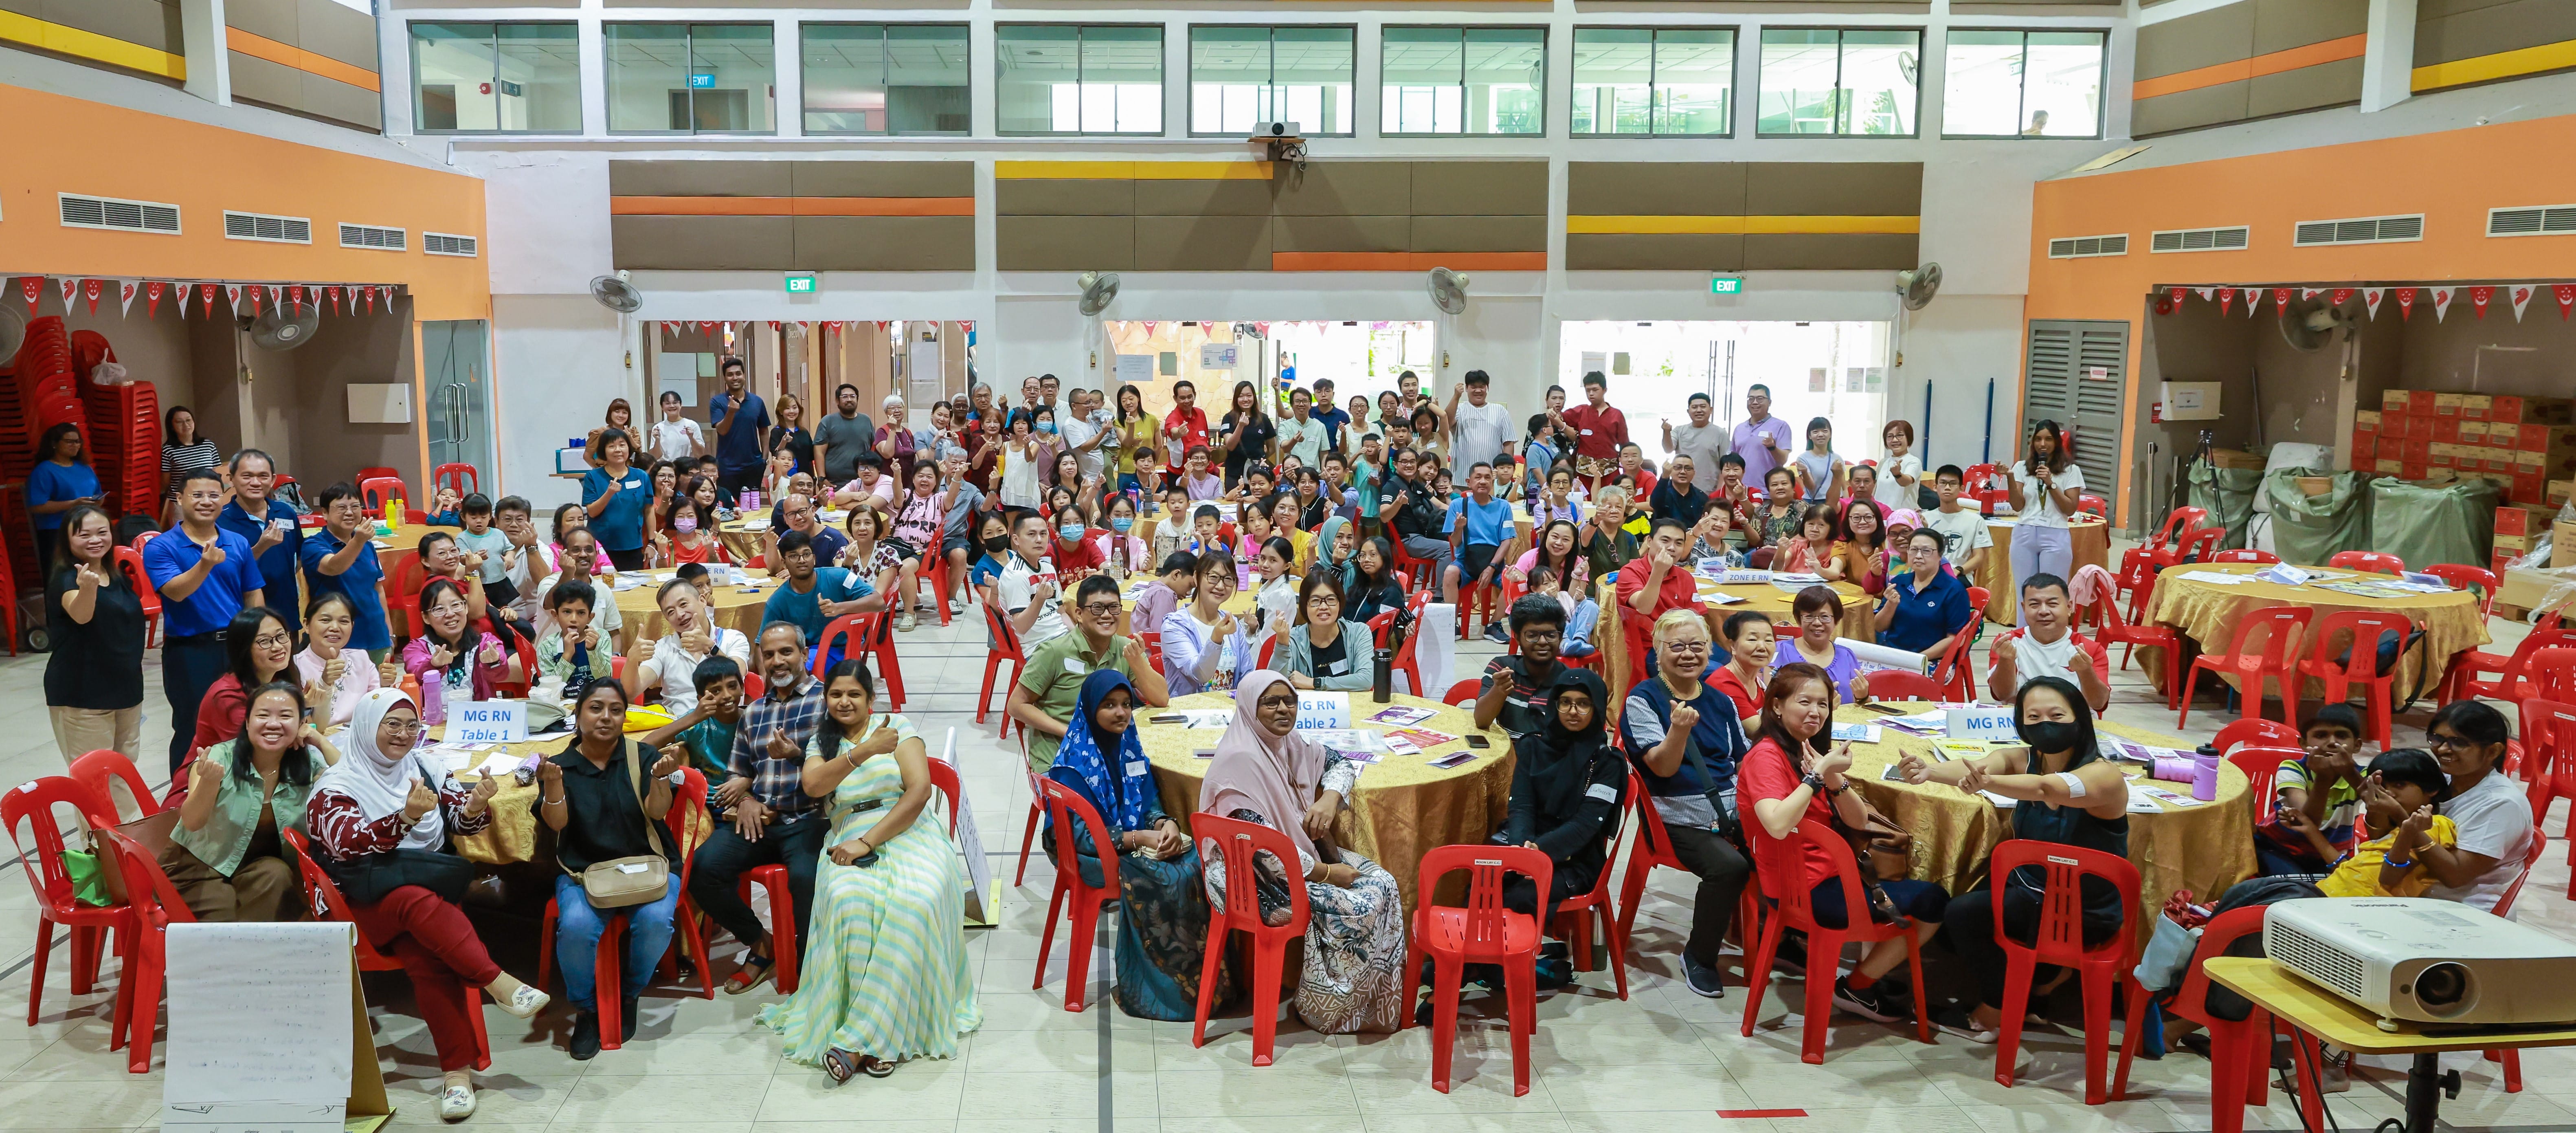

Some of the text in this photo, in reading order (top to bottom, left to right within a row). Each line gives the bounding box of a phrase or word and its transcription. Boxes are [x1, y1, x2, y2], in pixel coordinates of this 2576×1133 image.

[693, 76, 708, 85] EXIT
[790, 279, 810, 290] EXIT
[1717, 281, 1736, 291] EXIT
[1298, 701, 1335, 711] G RN
[464, 710, 512, 722] MG RN
[1296, 717, 1336, 729] able 2
[1967, 717, 1992, 730] MG
[461, 729, 508, 741] Table 1
